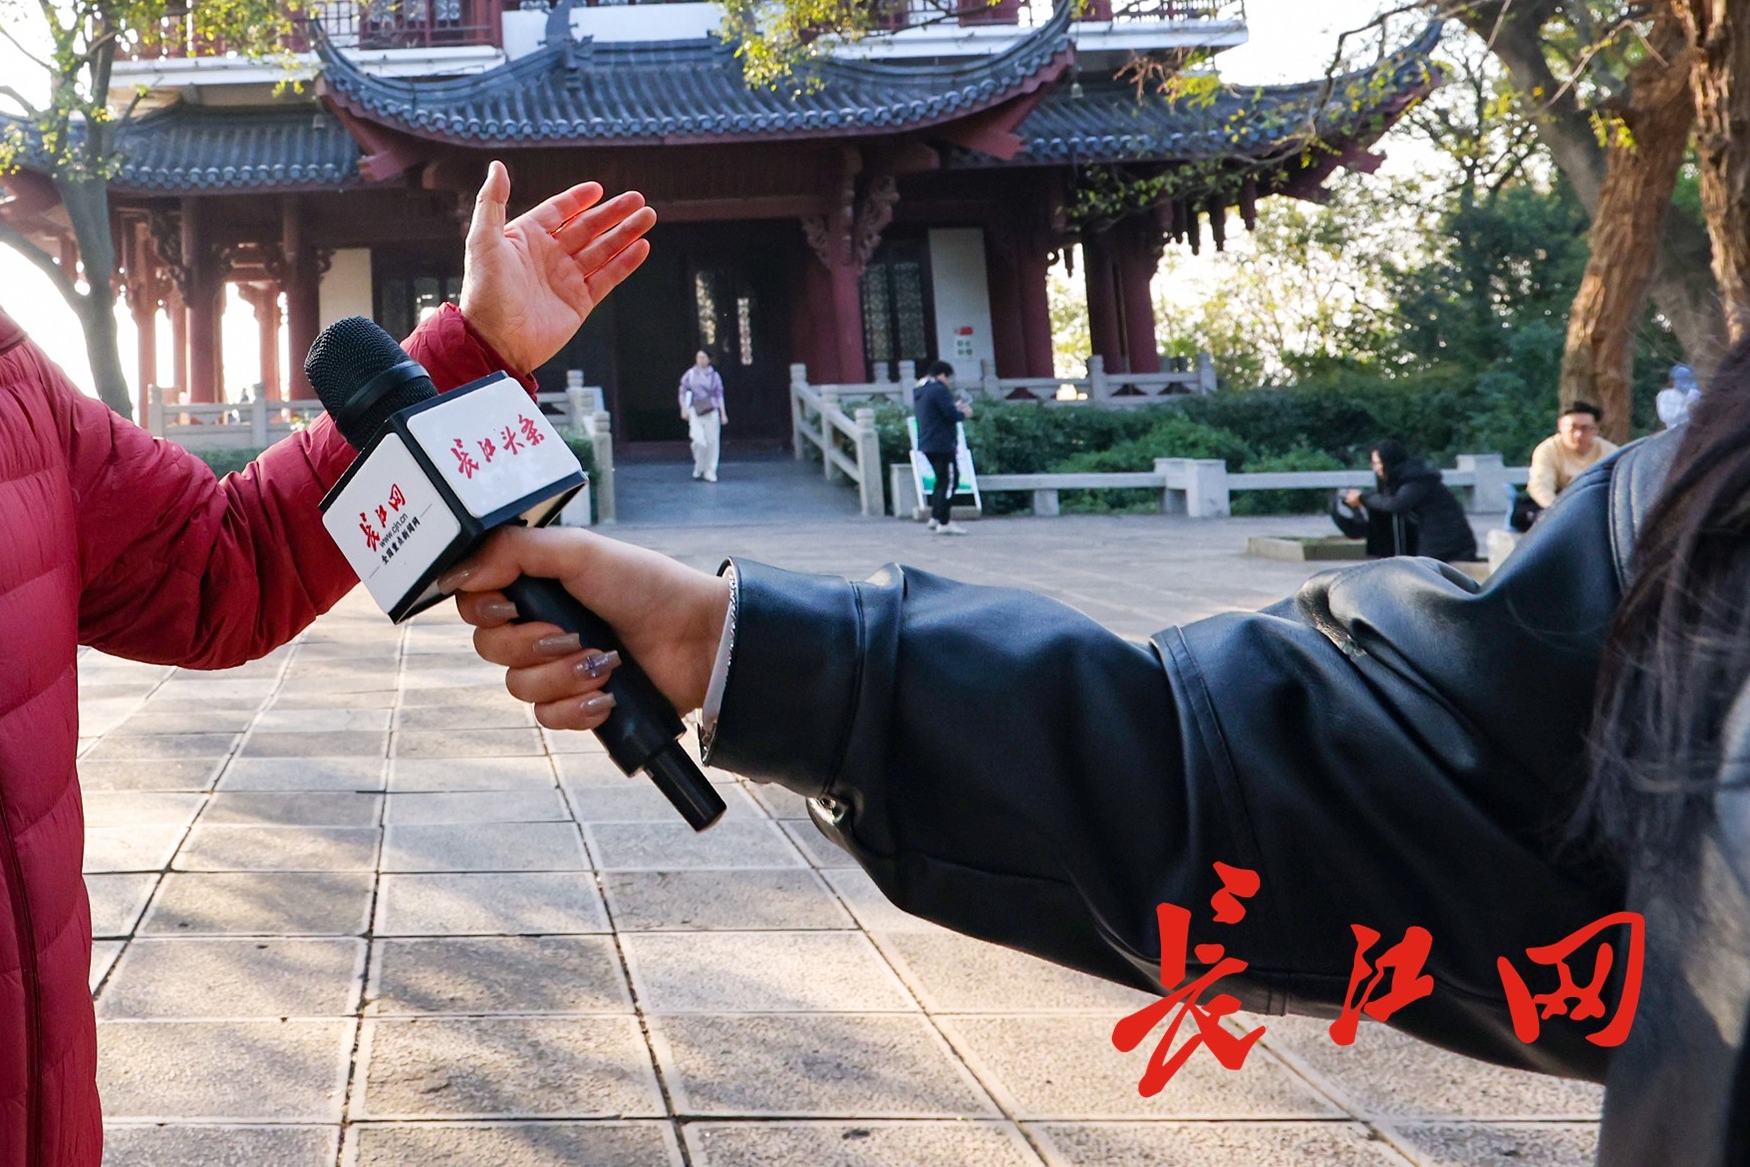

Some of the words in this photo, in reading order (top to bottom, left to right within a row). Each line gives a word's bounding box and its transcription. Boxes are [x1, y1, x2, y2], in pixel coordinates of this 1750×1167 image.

[451, 414, 545, 479] 长江头条
[359, 483, 405, 552] 长江网
[379, 513, 408, 548] www.cjn.cn
